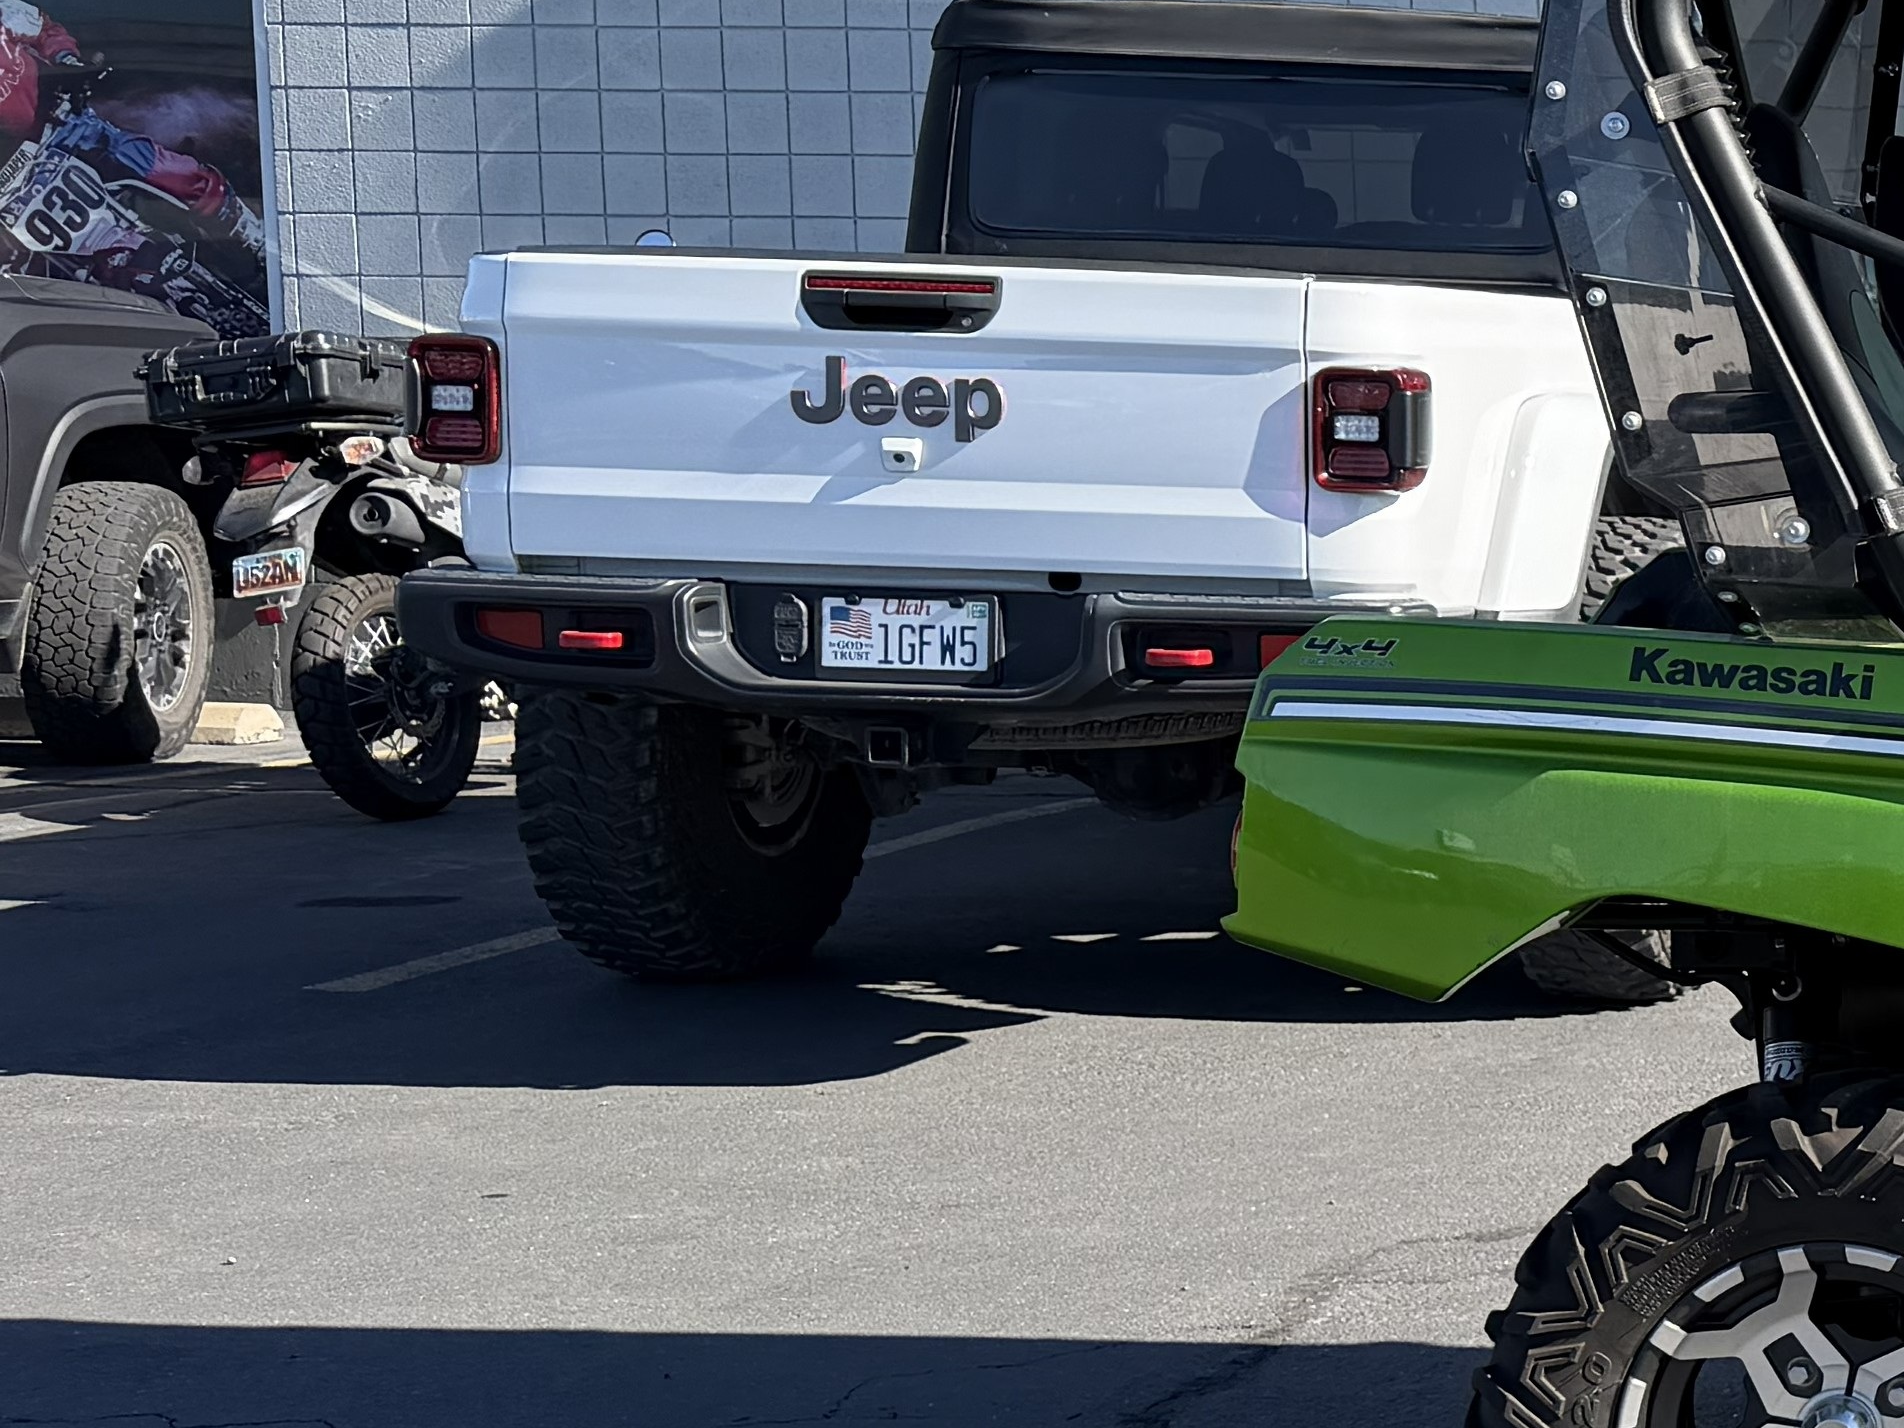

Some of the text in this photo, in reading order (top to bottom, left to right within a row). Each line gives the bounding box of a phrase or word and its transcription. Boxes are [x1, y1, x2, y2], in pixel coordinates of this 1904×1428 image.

[25, 164, 107, 252] 930
[790, 355, 1005, 443] Jeep
[881, 598, 931, 616] Utah
[832, 651, 871, 661] TRUST
[836, 640, 864, 651] GOD
[878, 623, 978, 667] 1GFW5
[1303, 636, 1399, 658] 4x4
[1628, 646, 1876, 701] Kawasaki
